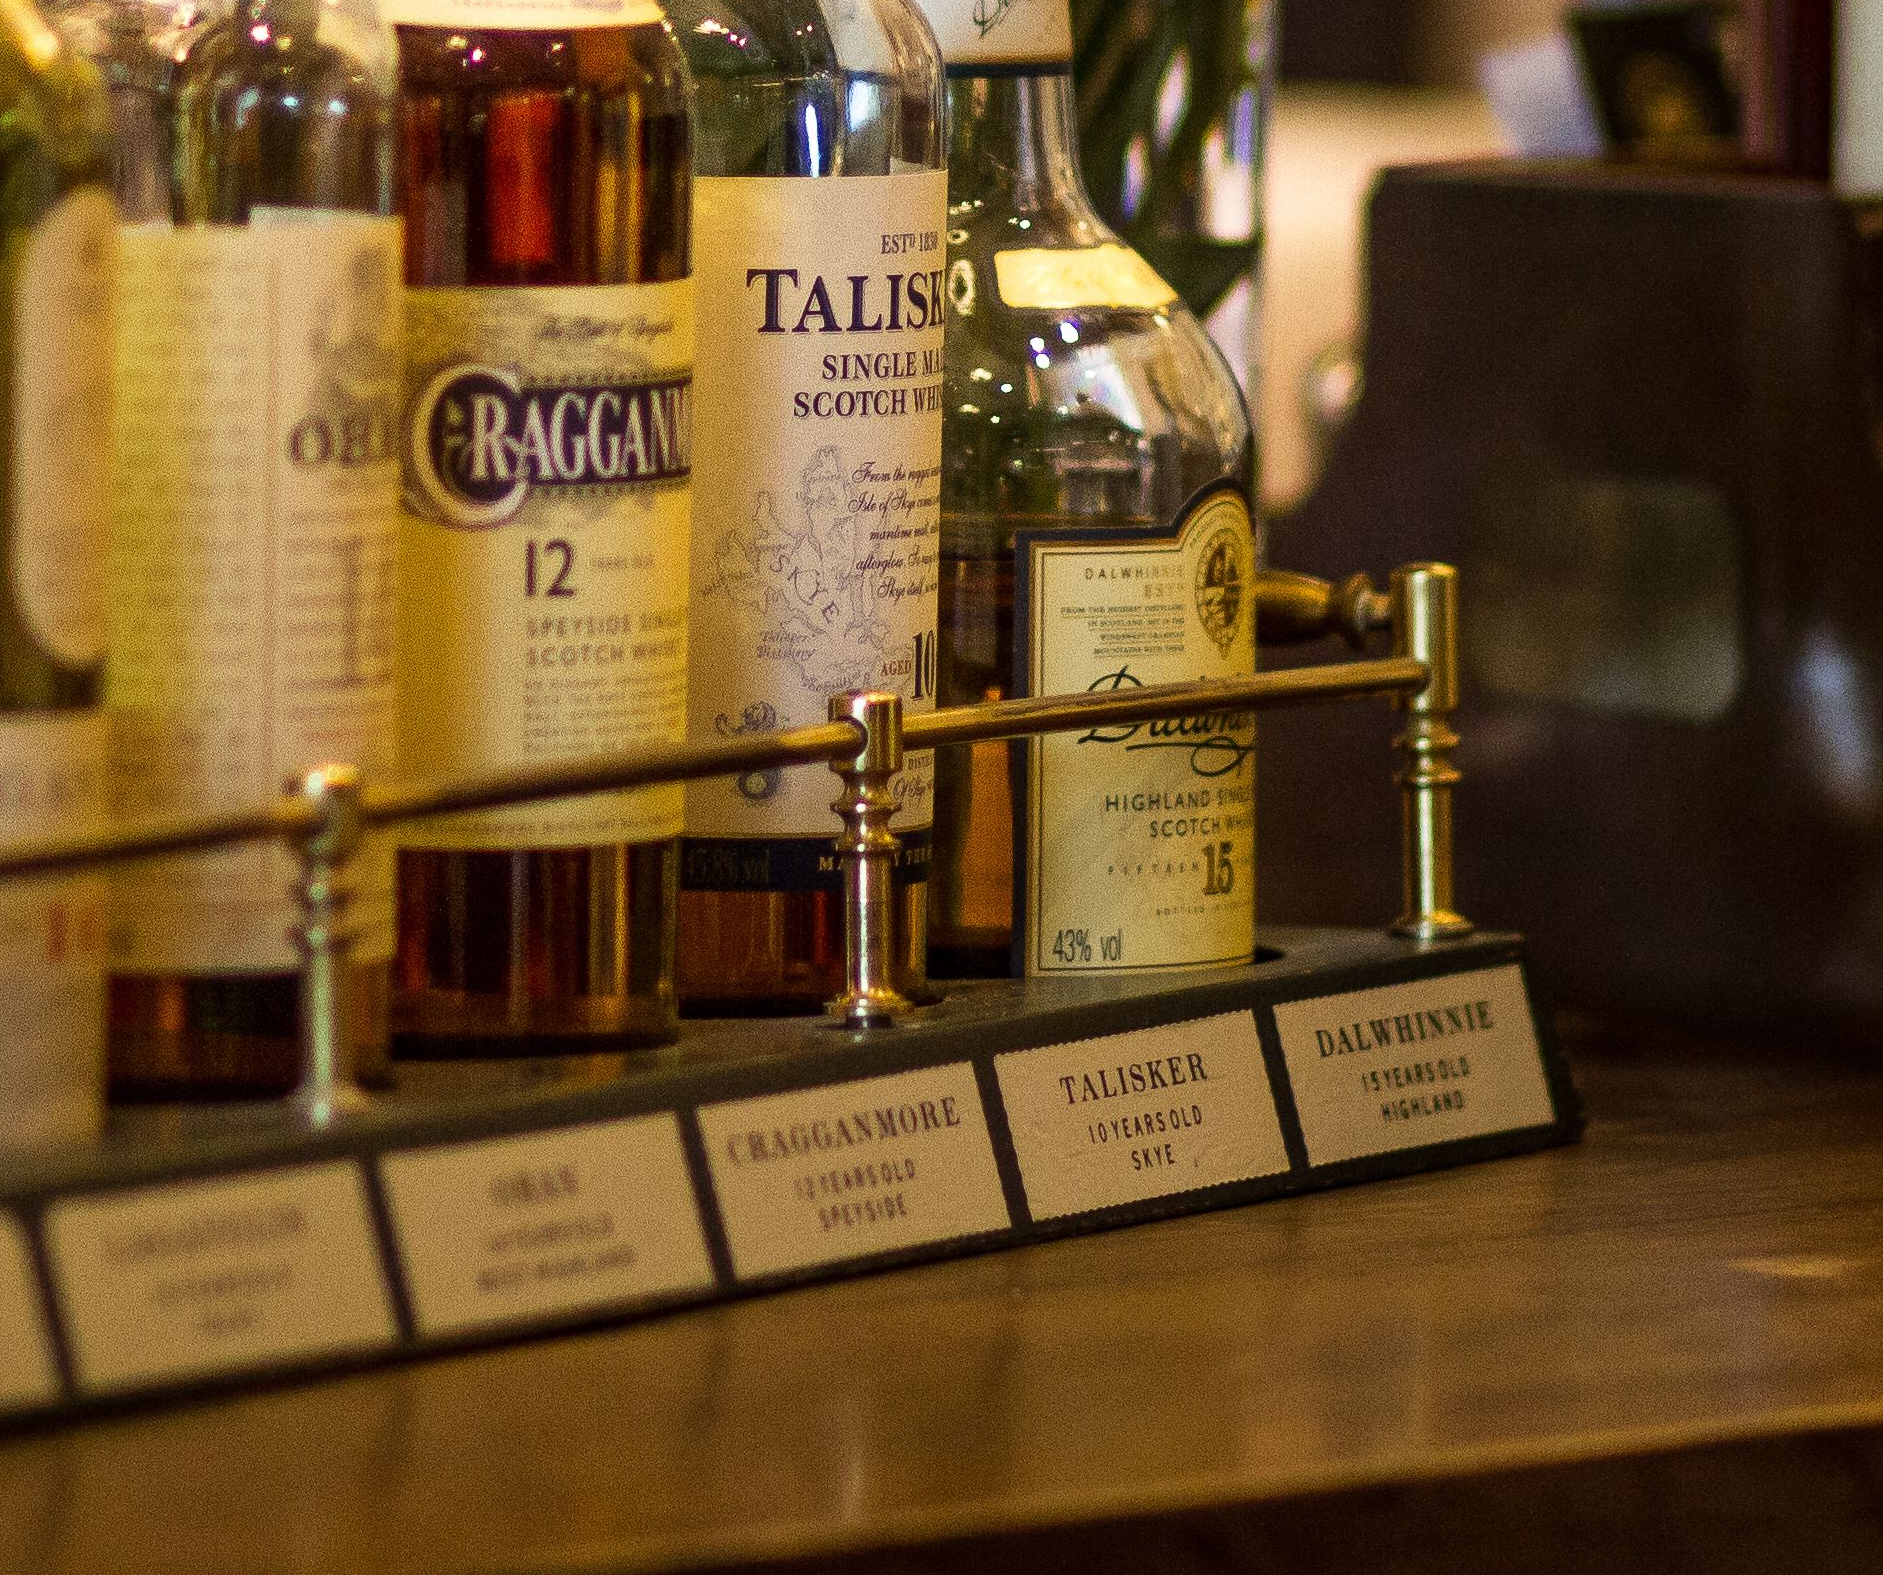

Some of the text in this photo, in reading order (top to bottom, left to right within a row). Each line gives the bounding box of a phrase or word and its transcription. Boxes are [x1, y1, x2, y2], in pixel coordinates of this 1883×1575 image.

[821, 351, 918, 382] SINGLE
[792, 390, 907, 419] SCOTCH
[847, 491, 877, 514] Isle
[878, 491, 894, 519] of
[524, 538, 577, 599] 12
[525, 642, 625, 669] SCOTCH
[880, 659, 912, 677] AGED
[911, 629, 935, 701] 10
[1105, 788, 1212, 813] HIGHLAND
[1149, 816, 1221, 840] SCOTCH
[1202, 840, 1236, 896] 15
[1051, 927, 1124, 963] 43% vol
[1315, 999, 1495, 1059] DALWHINNIE
[1059, 1052, 1209, 1105] TALISKER
[1380, 1087, 1464, 1123] HIGHLAND
[725, 1095, 962, 1168] CRAGGANMORE
[1130, 1142, 1177, 1172] SKYE
